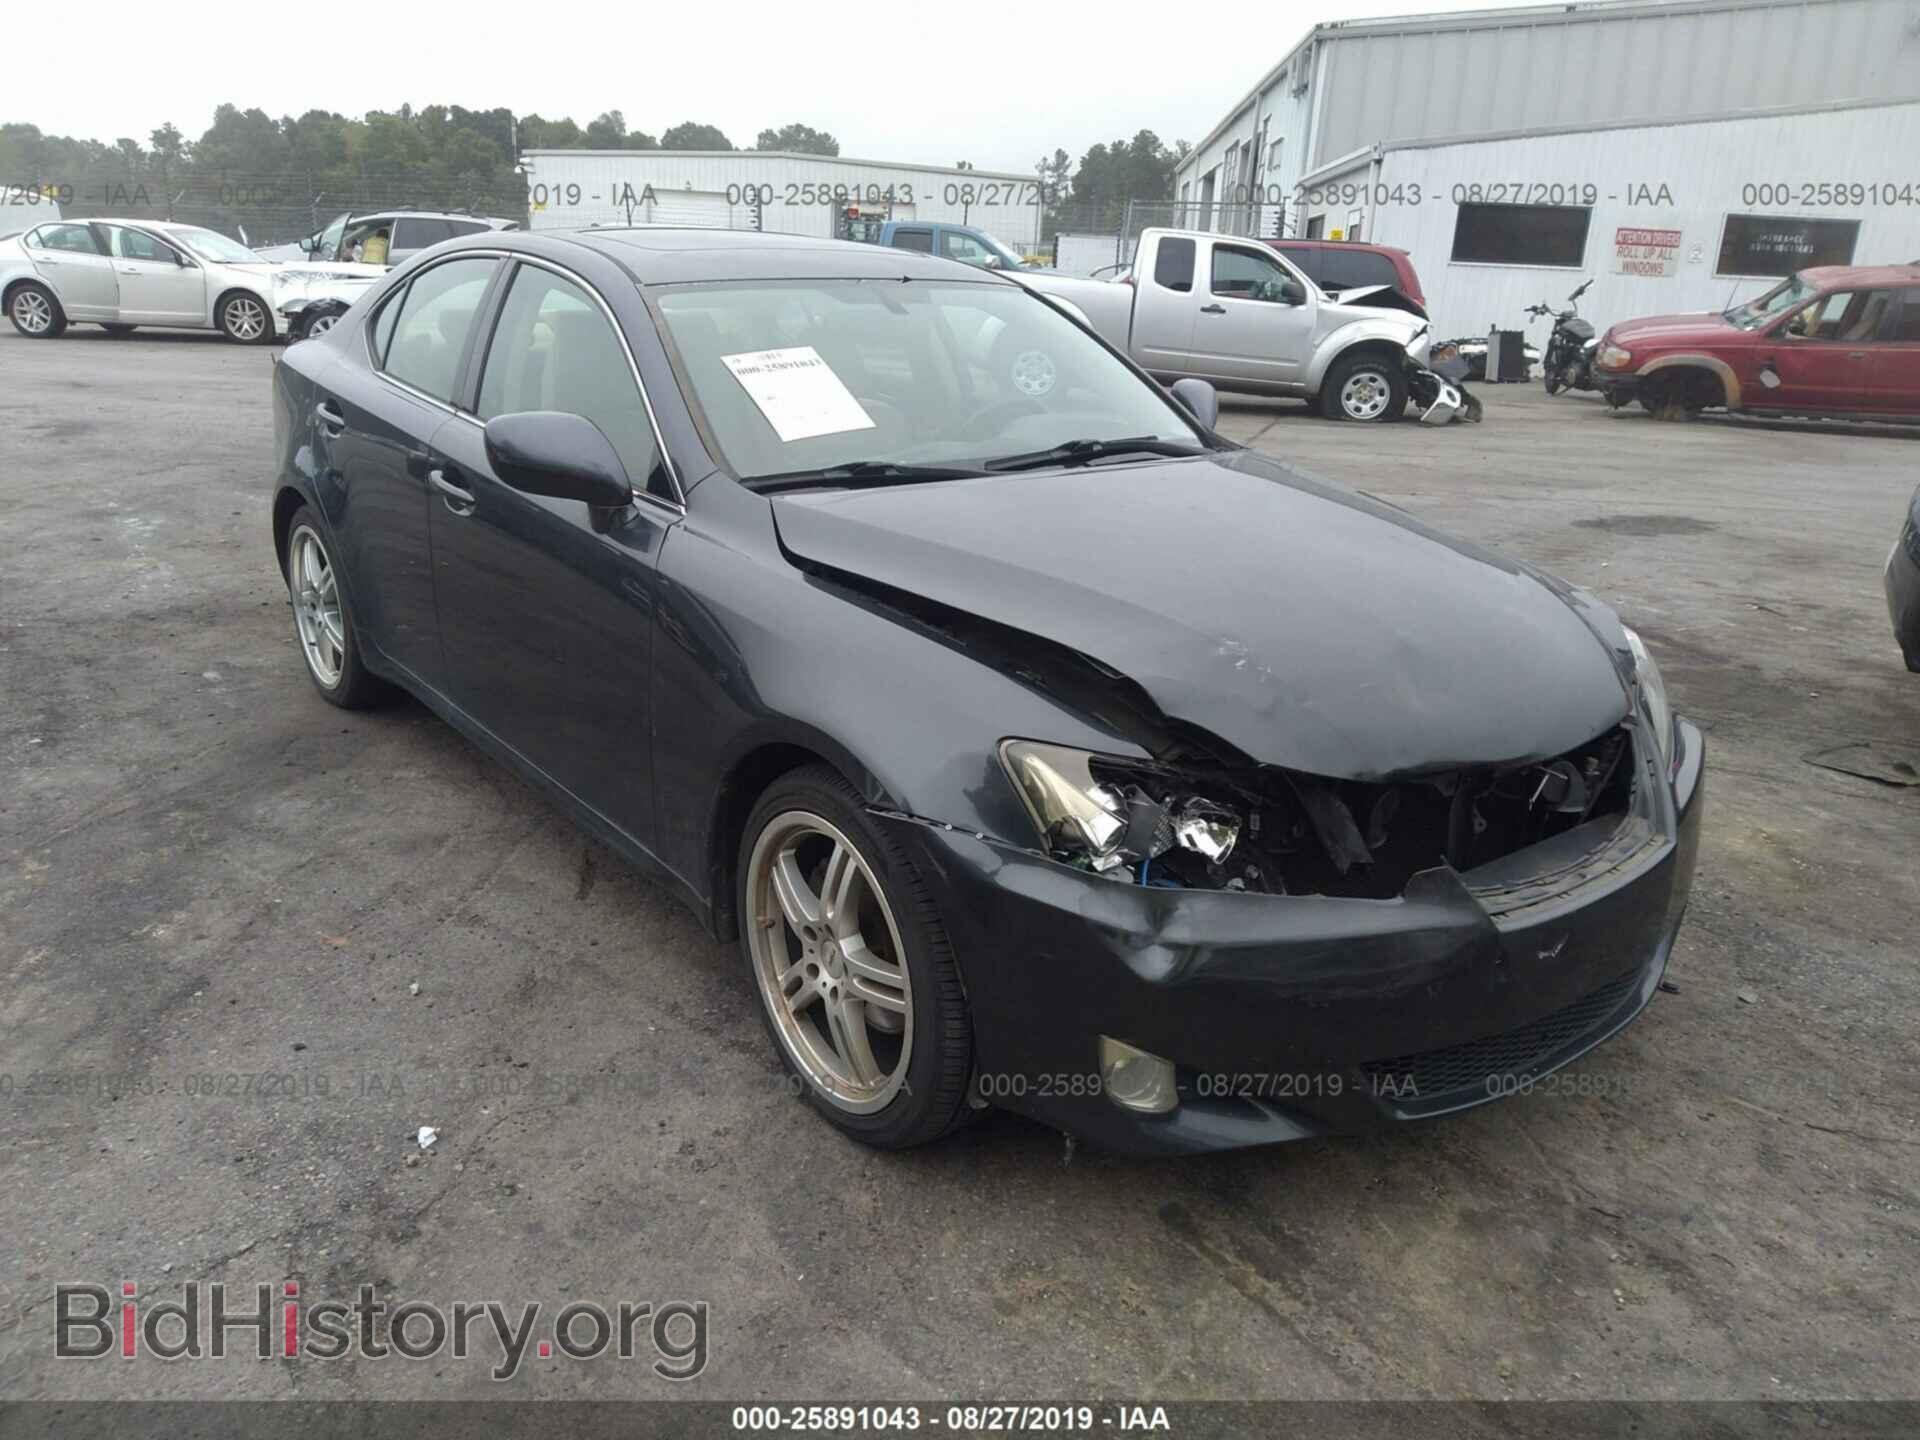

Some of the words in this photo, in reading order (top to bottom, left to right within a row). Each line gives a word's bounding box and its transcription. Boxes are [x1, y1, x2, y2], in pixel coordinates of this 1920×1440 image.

[1617, 246, 1639, 258] ROLL
[1643, 247, 1656, 259] UP
[1657, 248, 1673, 260] ALL
